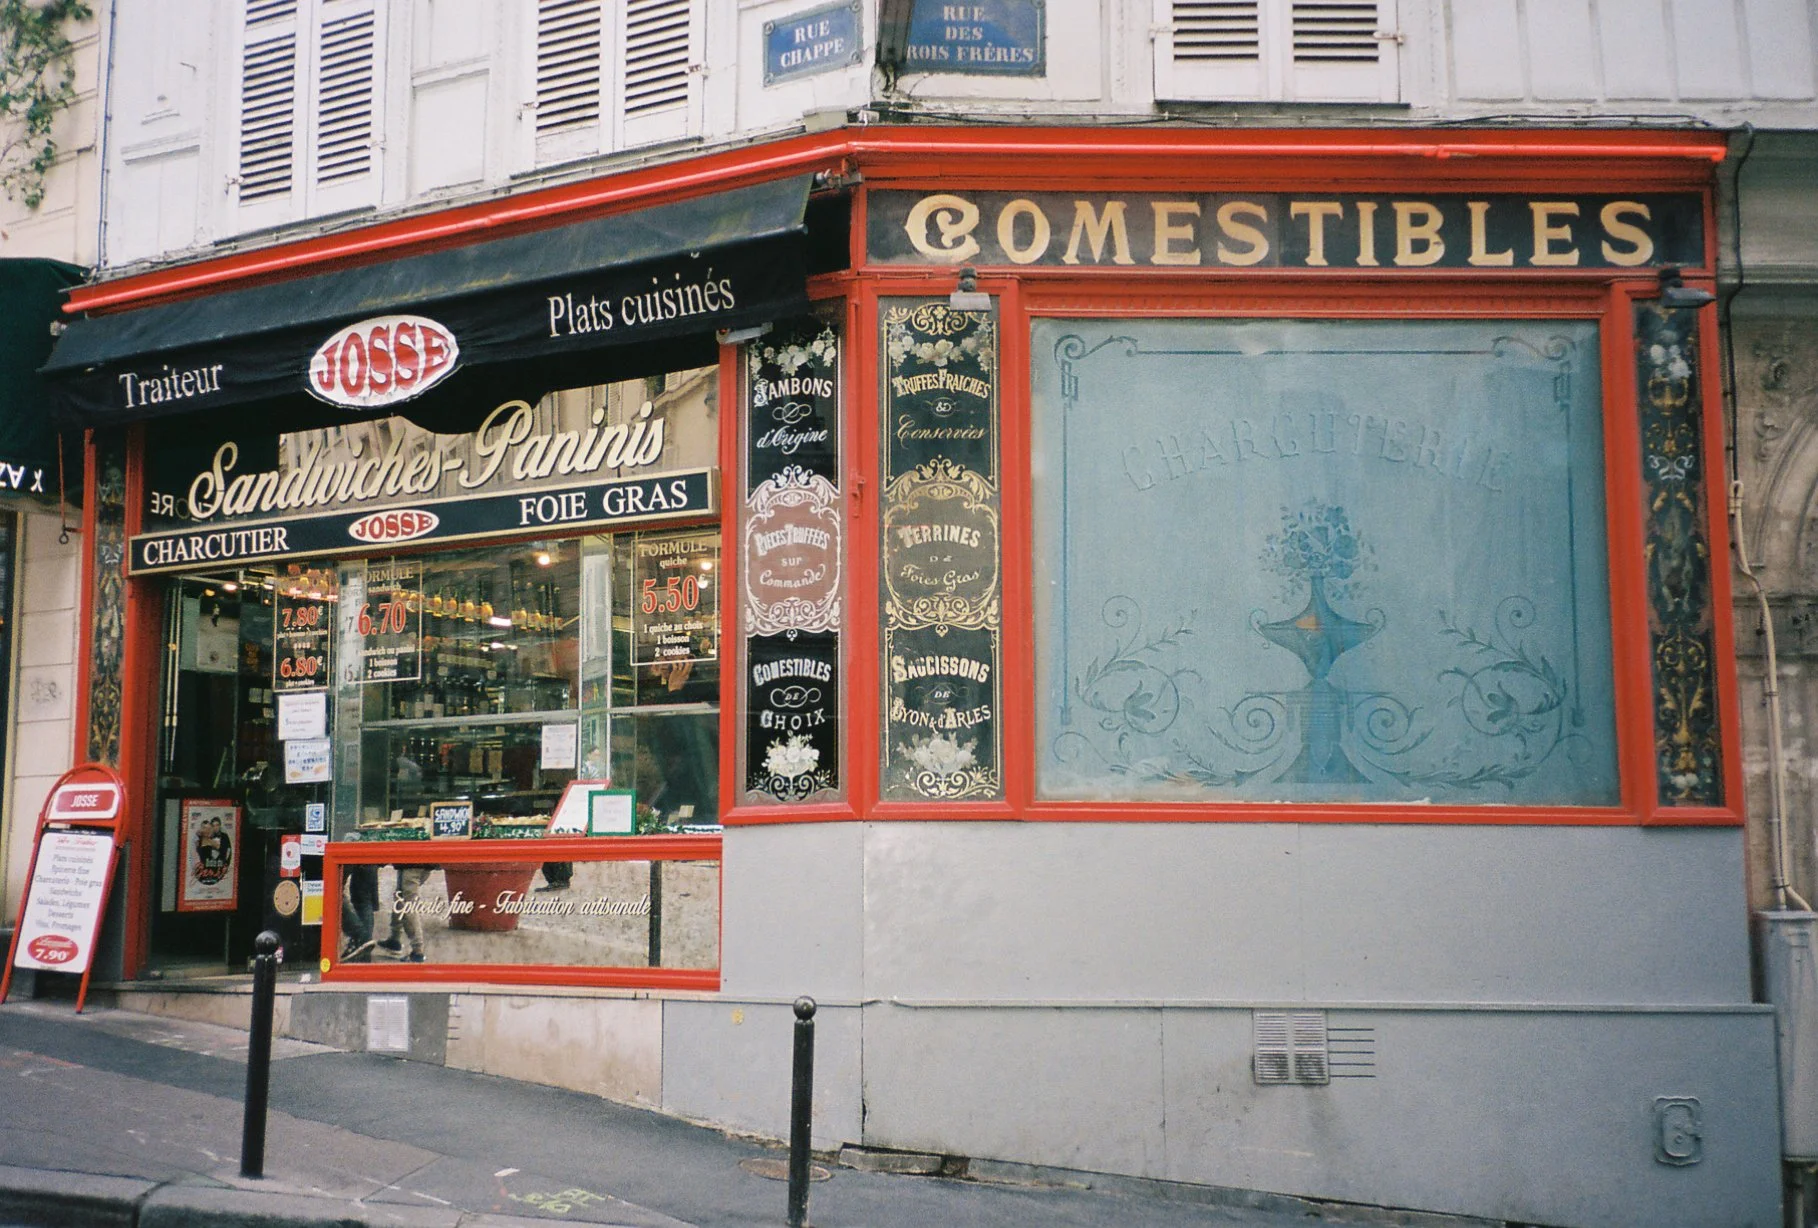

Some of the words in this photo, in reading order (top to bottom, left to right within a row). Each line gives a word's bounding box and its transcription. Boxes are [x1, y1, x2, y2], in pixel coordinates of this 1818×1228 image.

[943, 5, 985, 22] RUE
[794, 20, 830, 44] RUE
[945, 26, 984, 41] DES
[780, 38, 845, 68] CHAPPE
[906, 44, 950, 60] ROIS
[904, 193, 1656, 267] COMESTIBLES
[547, 291, 614, 338] Plats
[620, 266, 736, 326] cuisinés
[317, 320, 450, 398] JOSSE
[118, 364, 224, 409] Traiteur
[753, 377, 833, 408] JAMBONS
[891, 372, 939, 398] TRUFFES
[459, 399, 666, 489] Paninis
[1121, 411, 1511, 493] CHARCUTERIE
[519, 492, 589, 526] FOIE
[602, 480, 689, 517] GRAS
[355, 512, 433, 540] JOSSE
[897, 524, 981, 548] TERRINES
[143, 527, 290, 566] CHARCUTIER
[640, 541, 708, 557] FORMULE
[659, 556, 688, 570] quiche
[781, 557, 802, 566] sur
[759, 563, 827, 589] Commande
[662, 634, 690, 645] boisson
[662, 646, 691, 657] cookies
[753, 658, 832, 687] COMESTIBLES
[892, 654, 991, 684] SAUCISSONS
[785, 692, 800, 701] DE
[934, 690, 952, 698] DE
[759, 707, 826, 730] CHOIX
[70, 793, 99, 808] JOSSE
[580, 894, 652, 916] artisanale
